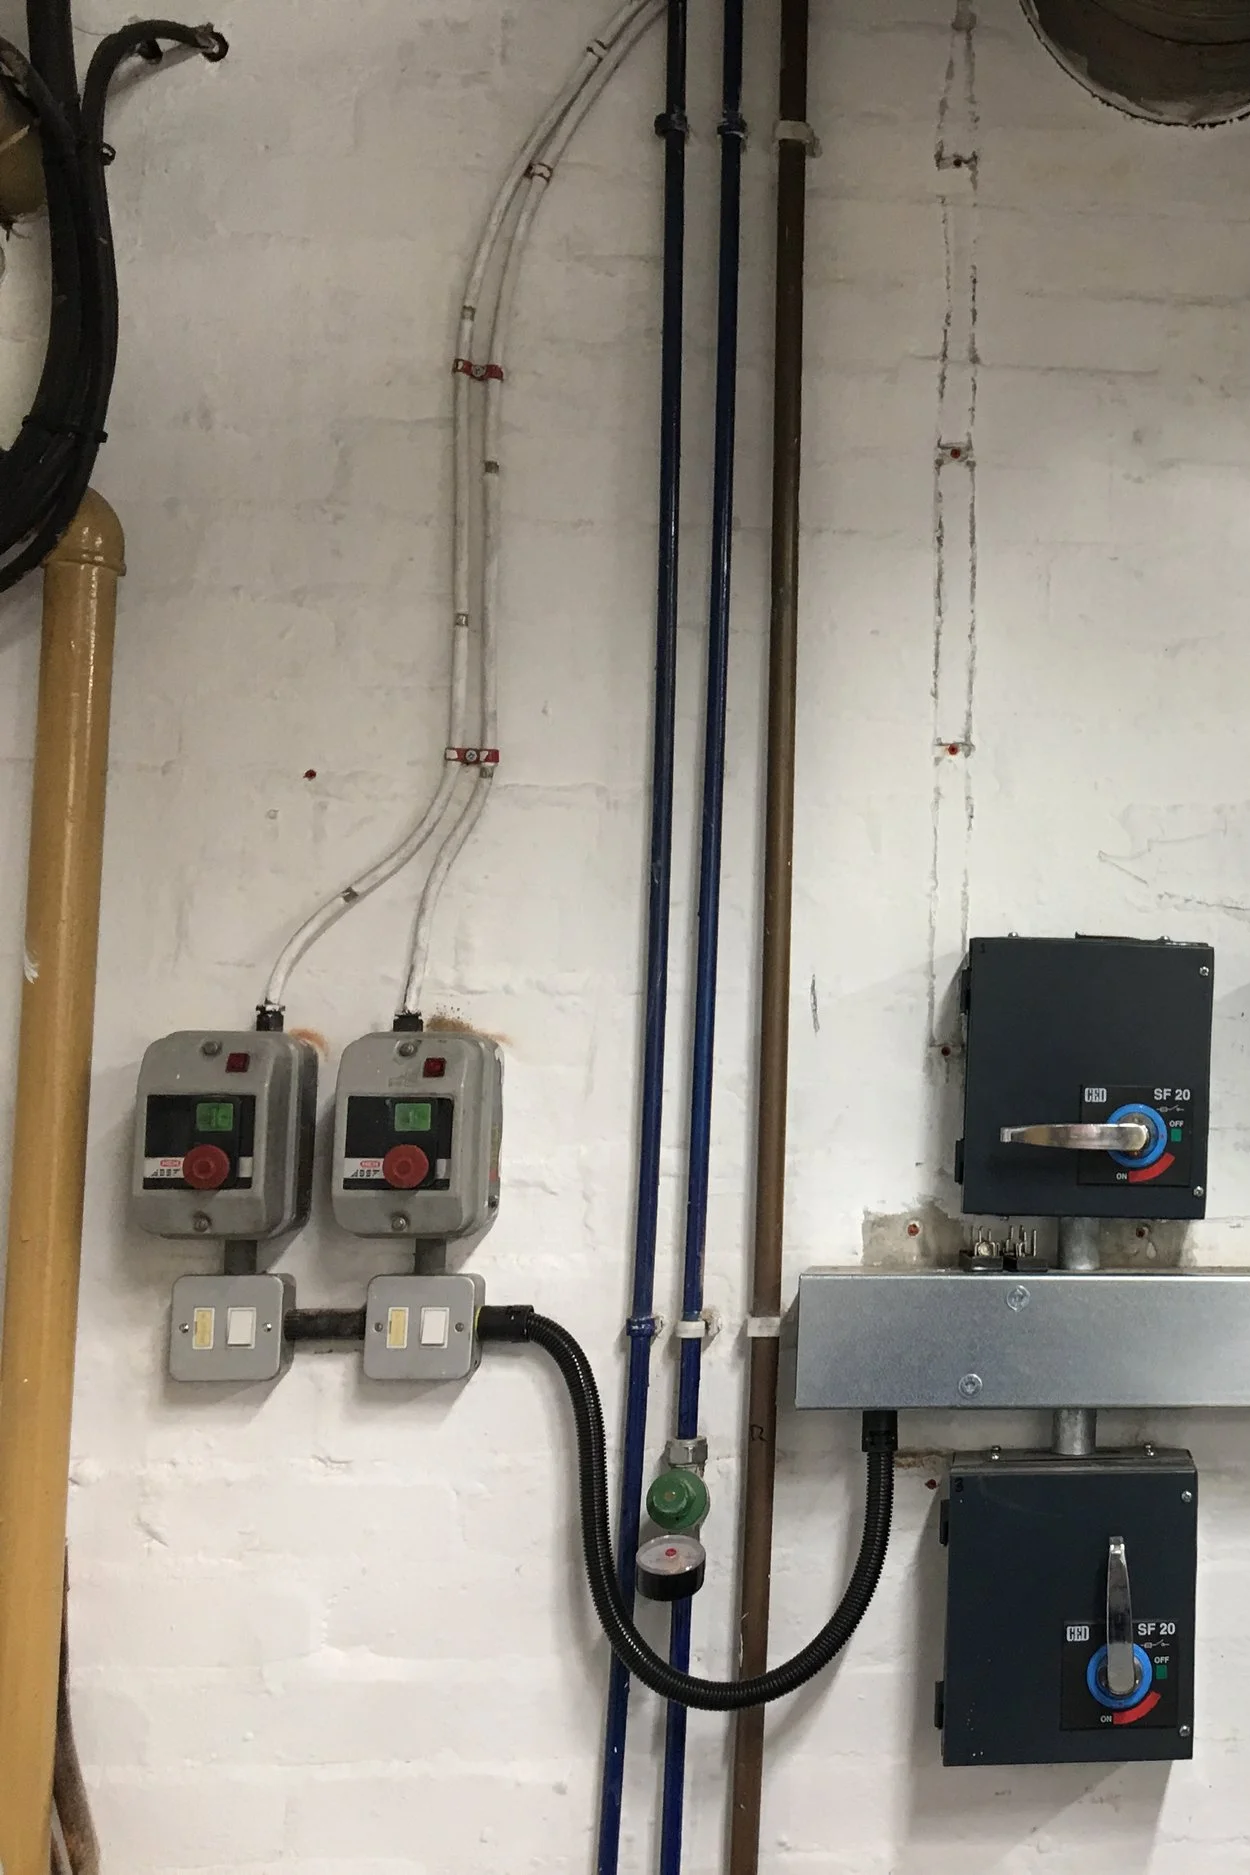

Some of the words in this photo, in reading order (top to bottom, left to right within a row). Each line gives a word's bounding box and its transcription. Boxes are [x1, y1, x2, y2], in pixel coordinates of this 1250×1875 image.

[1084, 1087, 1107, 1103] CED
[1154, 1088, 1171, 1101] SF
[1175, 1088, 1191, 1101] 20
[1169, 1120, 1184, 1128] OFF
[1116, 1172, 1128, 1180] ON
[954, 1476, 964, 1492] 3
[1066, 1625, 1090, 1642] CED
[1138, 1623, 1156, 1636] SF
[1159, 1623, 1176, 1635] 20
[1154, 1656, 1170, 1664] OFF
[1100, 1715, 1112, 1723] ON
